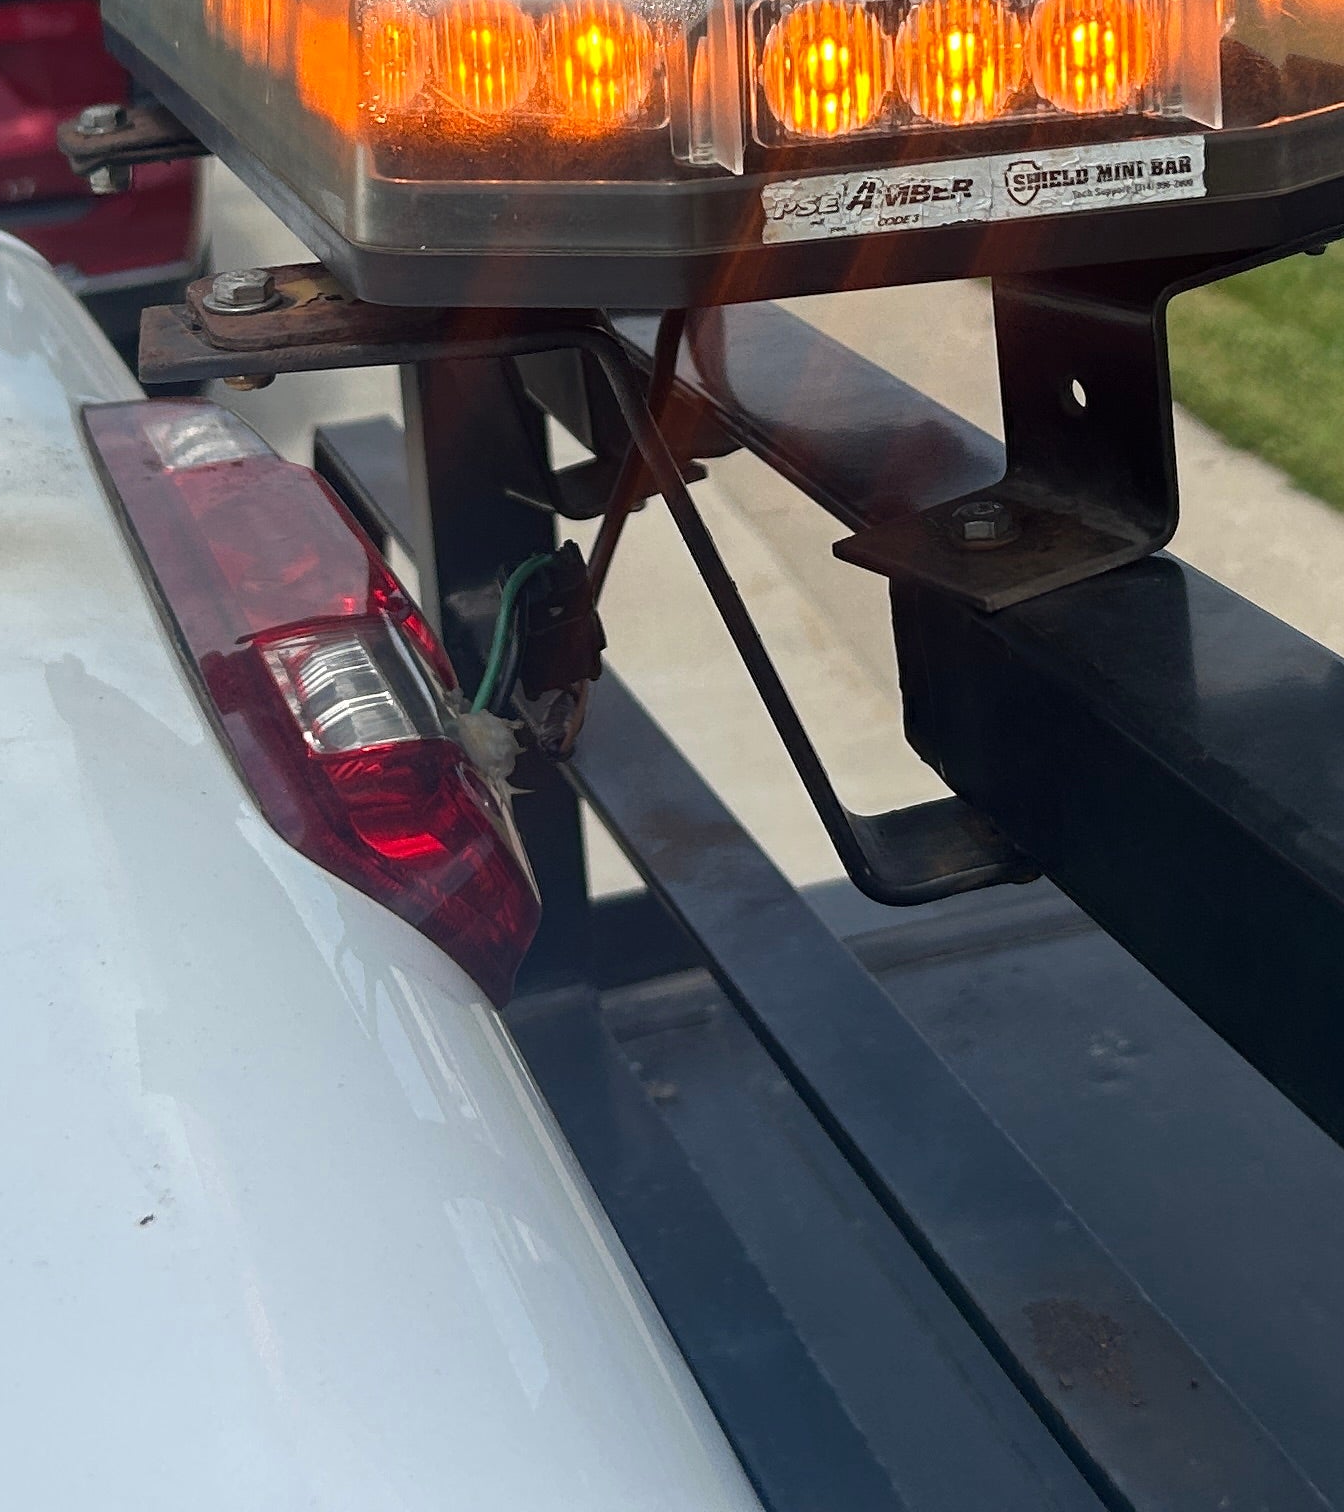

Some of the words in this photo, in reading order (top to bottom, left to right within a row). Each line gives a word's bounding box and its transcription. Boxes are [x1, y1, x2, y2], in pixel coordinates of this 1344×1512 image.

[1013, 168, 1089, 192] SHIELD
[1096, 161, 1143, 183] MINI
[1150, 156, 1192, 176] BAR
[773, 193, 841, 219] PSE
[877, 214, 911, 227] CODE
